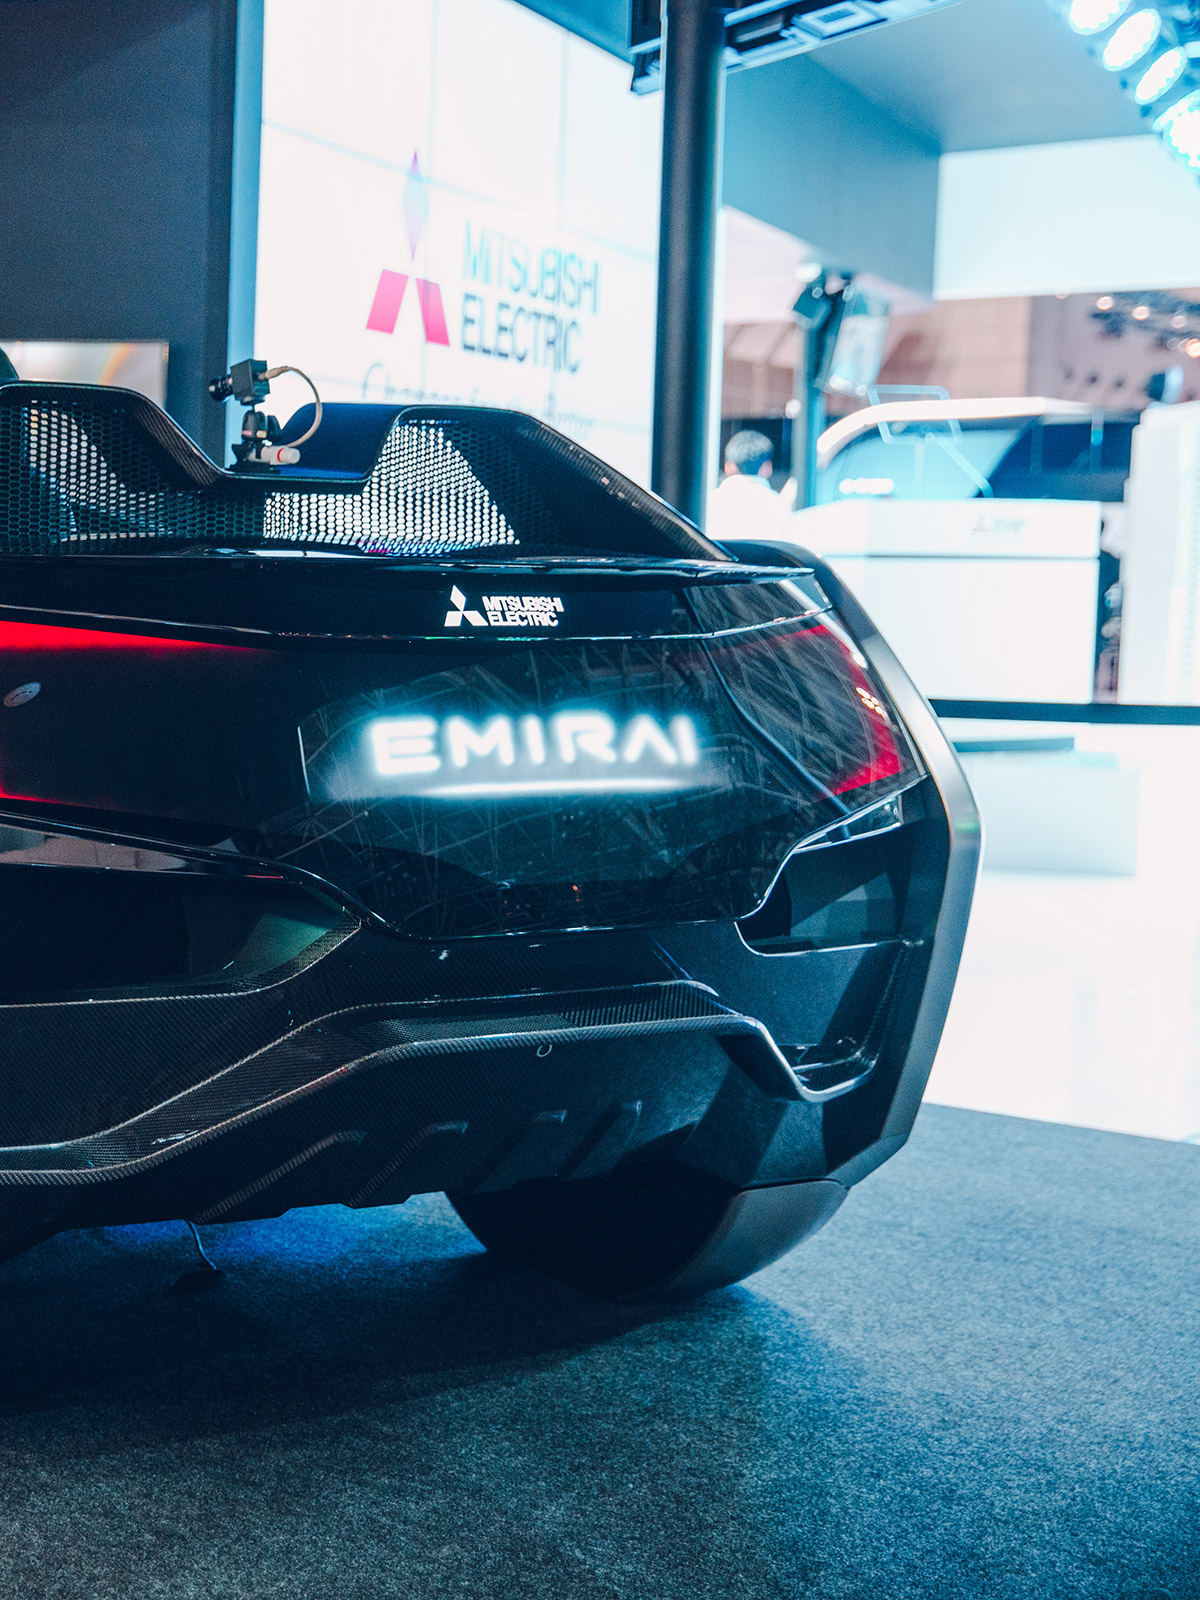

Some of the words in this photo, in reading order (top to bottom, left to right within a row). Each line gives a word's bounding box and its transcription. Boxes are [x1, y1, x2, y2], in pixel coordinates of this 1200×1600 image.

[461, 291, 583, 375] ELECTRIC
[481, 596, 564, 612] MITSUBISHI
[487, 611, 558, 627] ELECTRIC
[370, 709, 699, 776] EMIRAI
